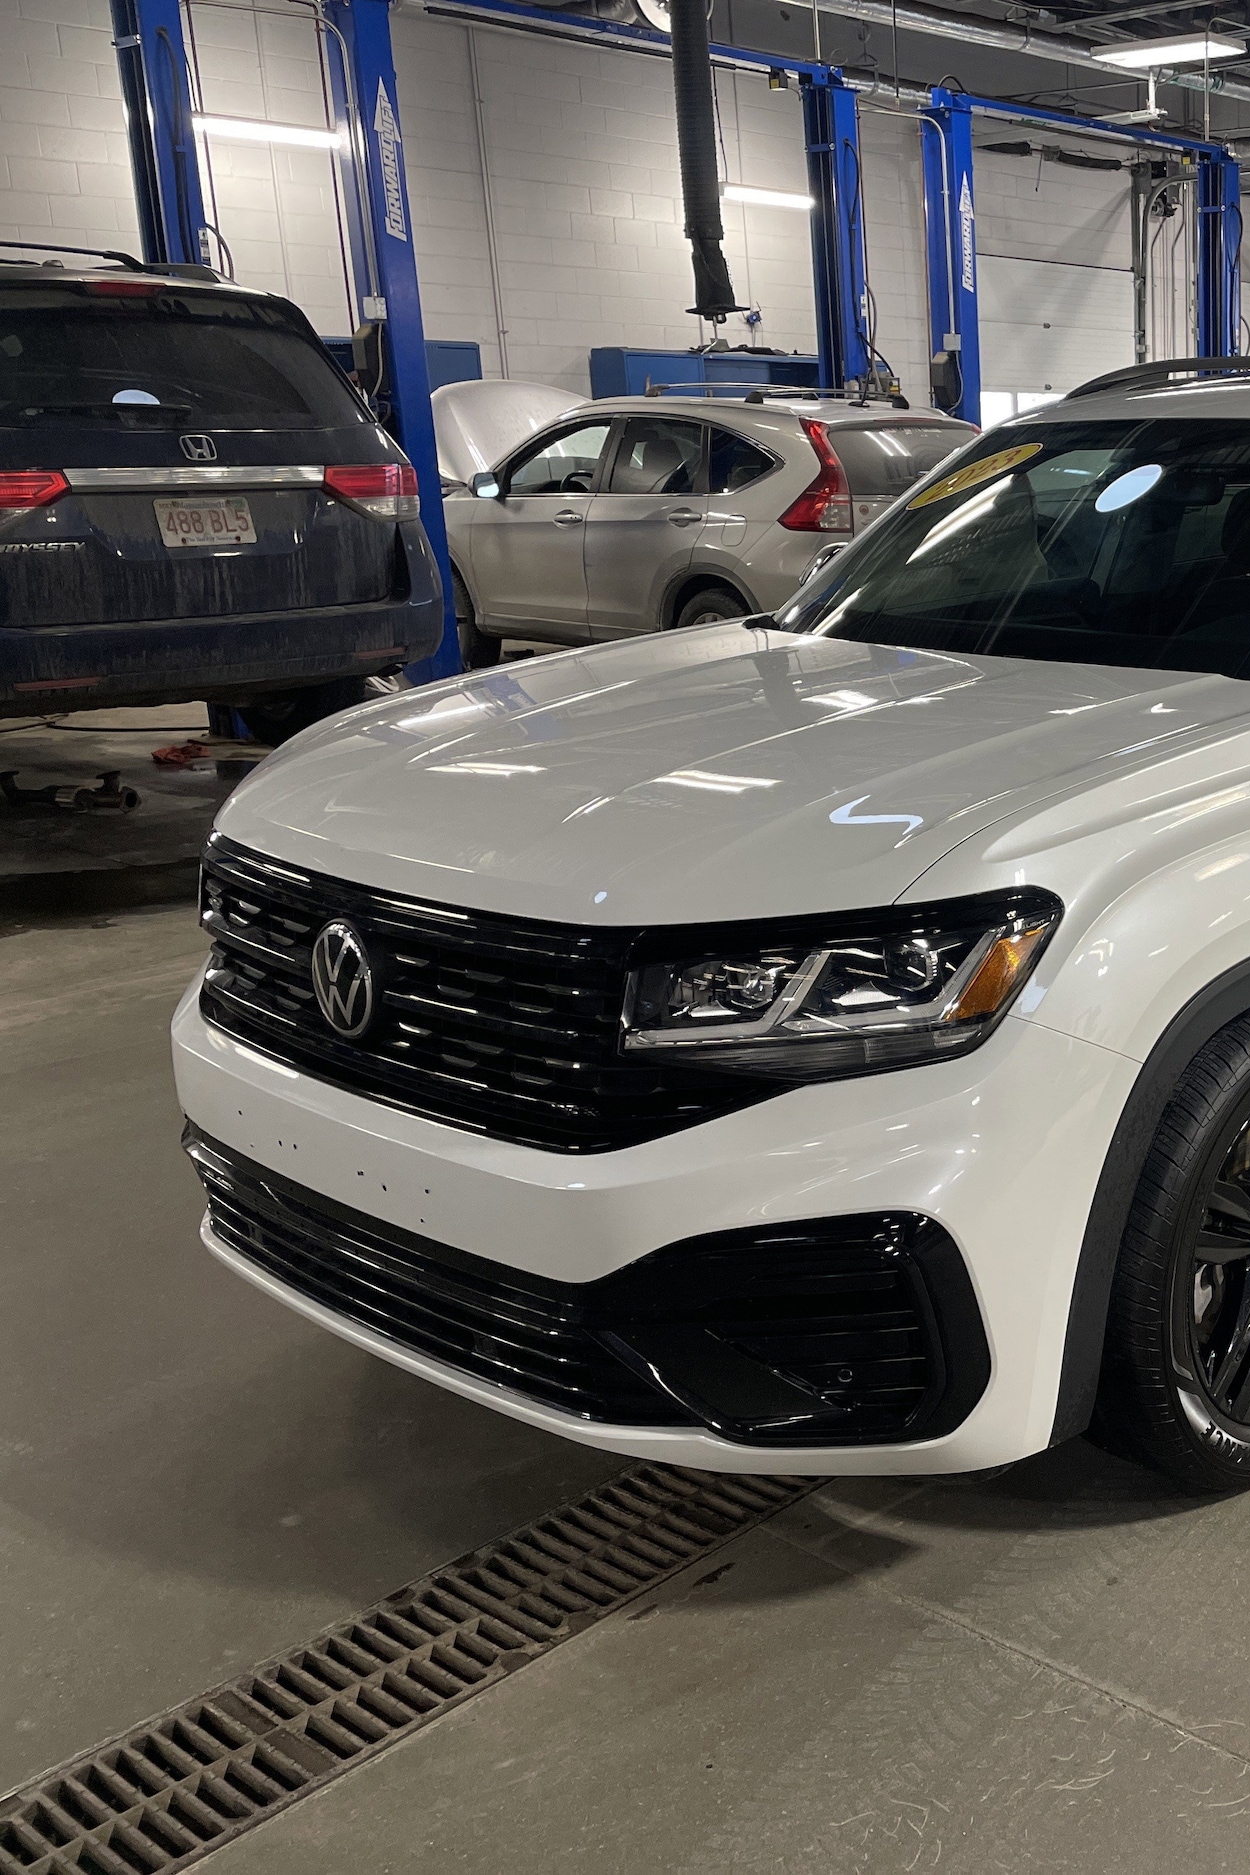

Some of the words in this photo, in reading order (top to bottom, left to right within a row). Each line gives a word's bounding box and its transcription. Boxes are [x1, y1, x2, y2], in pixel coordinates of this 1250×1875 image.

[926, 449, 1023, 502] 2023
[166, 510, 205, 535] 488
[208, 509, 250, 533] BL5
